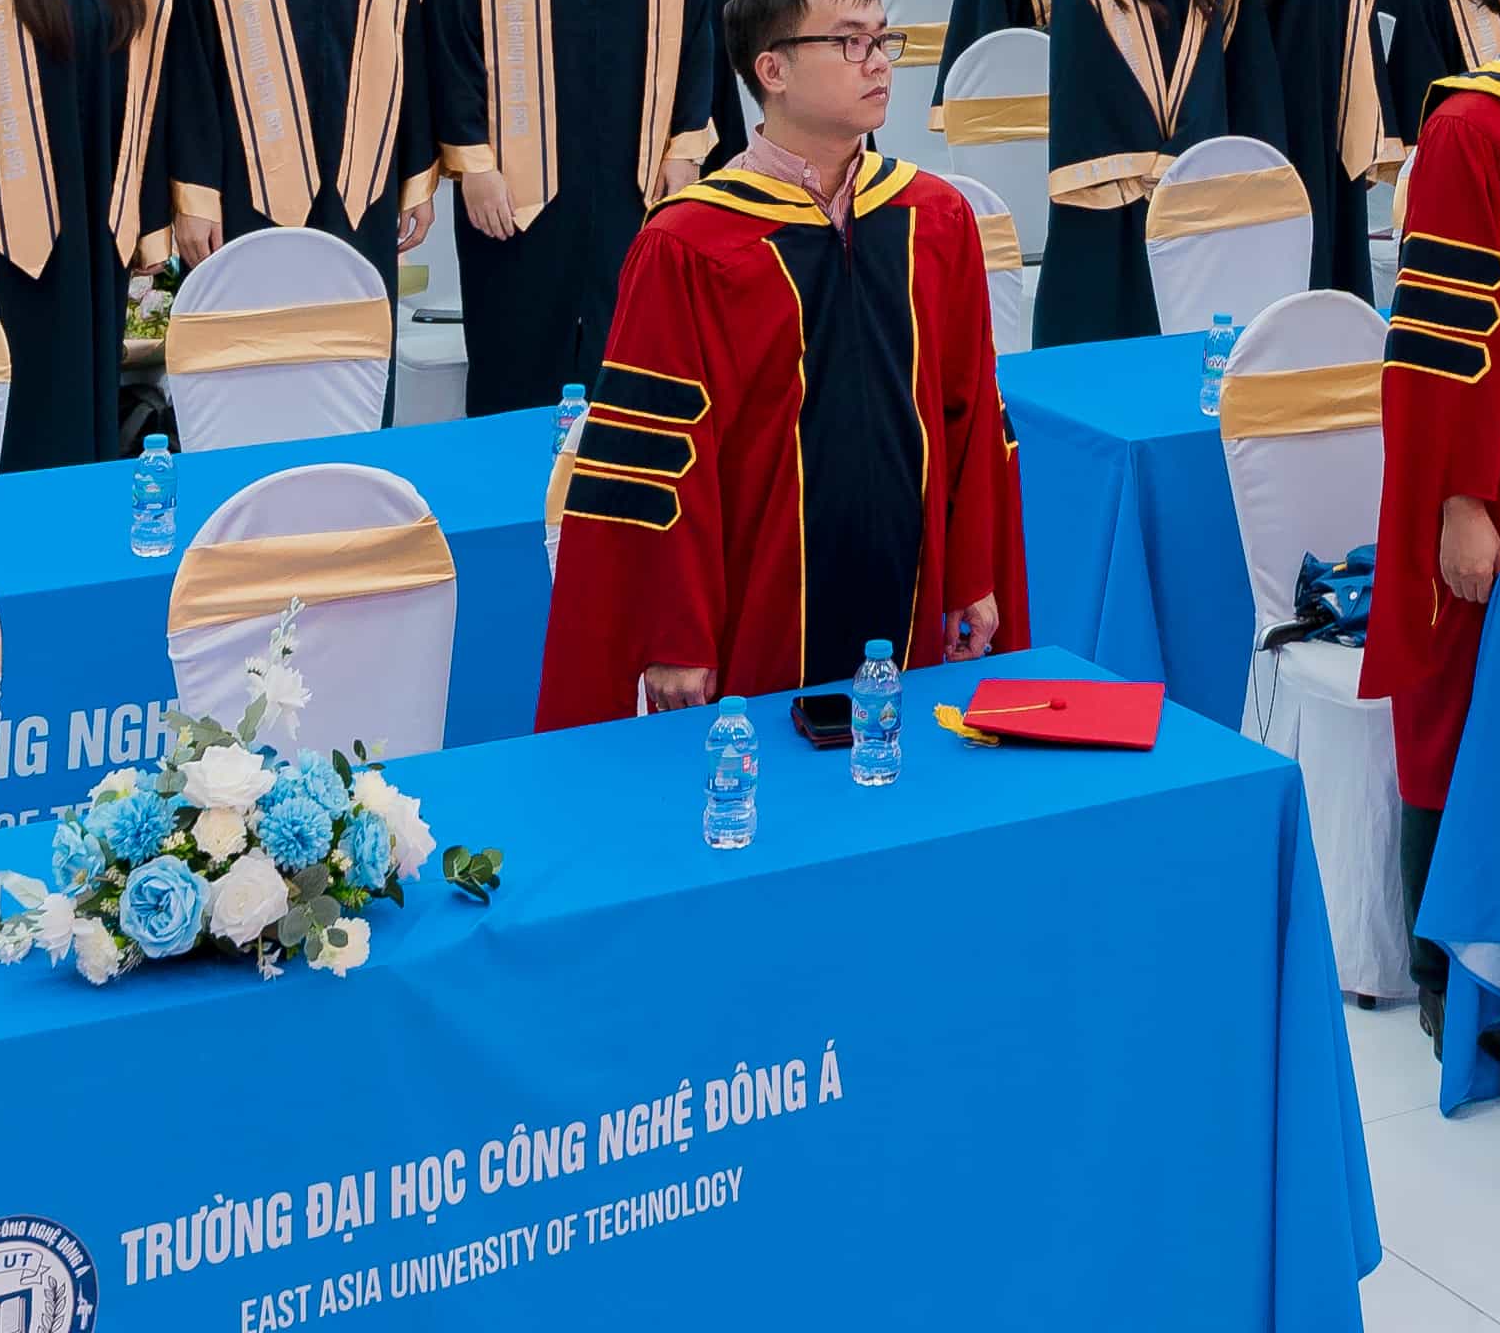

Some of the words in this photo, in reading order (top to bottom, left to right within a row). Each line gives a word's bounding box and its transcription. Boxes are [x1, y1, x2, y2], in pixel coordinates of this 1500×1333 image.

[255, 72, 275, 104] Asia
[505, 69, 525, 102] Asia
[261, 109, 284, 143] East
[505, 107, 527, 136] East
[3, 148, 27, 181] East
[68, 699, 178, 770] NGH
[121, 1192, 292, 1286] TRƯỜNG
[306, 1171, 375, 1243] ĐẠI
[391, 1149, 466, 1224] HỌC
[479, 1121, 586, 1193] CÔNG
[598, 1079, 693, 1164] NGHỆ
[704, 1059, 806, 1133] ĐÔNG
[818, 1039, 842, 1103] Á
[28, 1221, 61, 1247] NGHỆ
[55, 1235, 85, 1268] ĐÔNG
[75, 1262, 92, 1279] Á
[241, 1284, 311, 1333] EAST
[319, 1267, 382, 1317] ASIA
[391, 1224, 539, 1298] UNIVERSITY
[547, 1214, 577, 1255] OF
[584, 1166, 742, 1244] TECHNOLOGY
